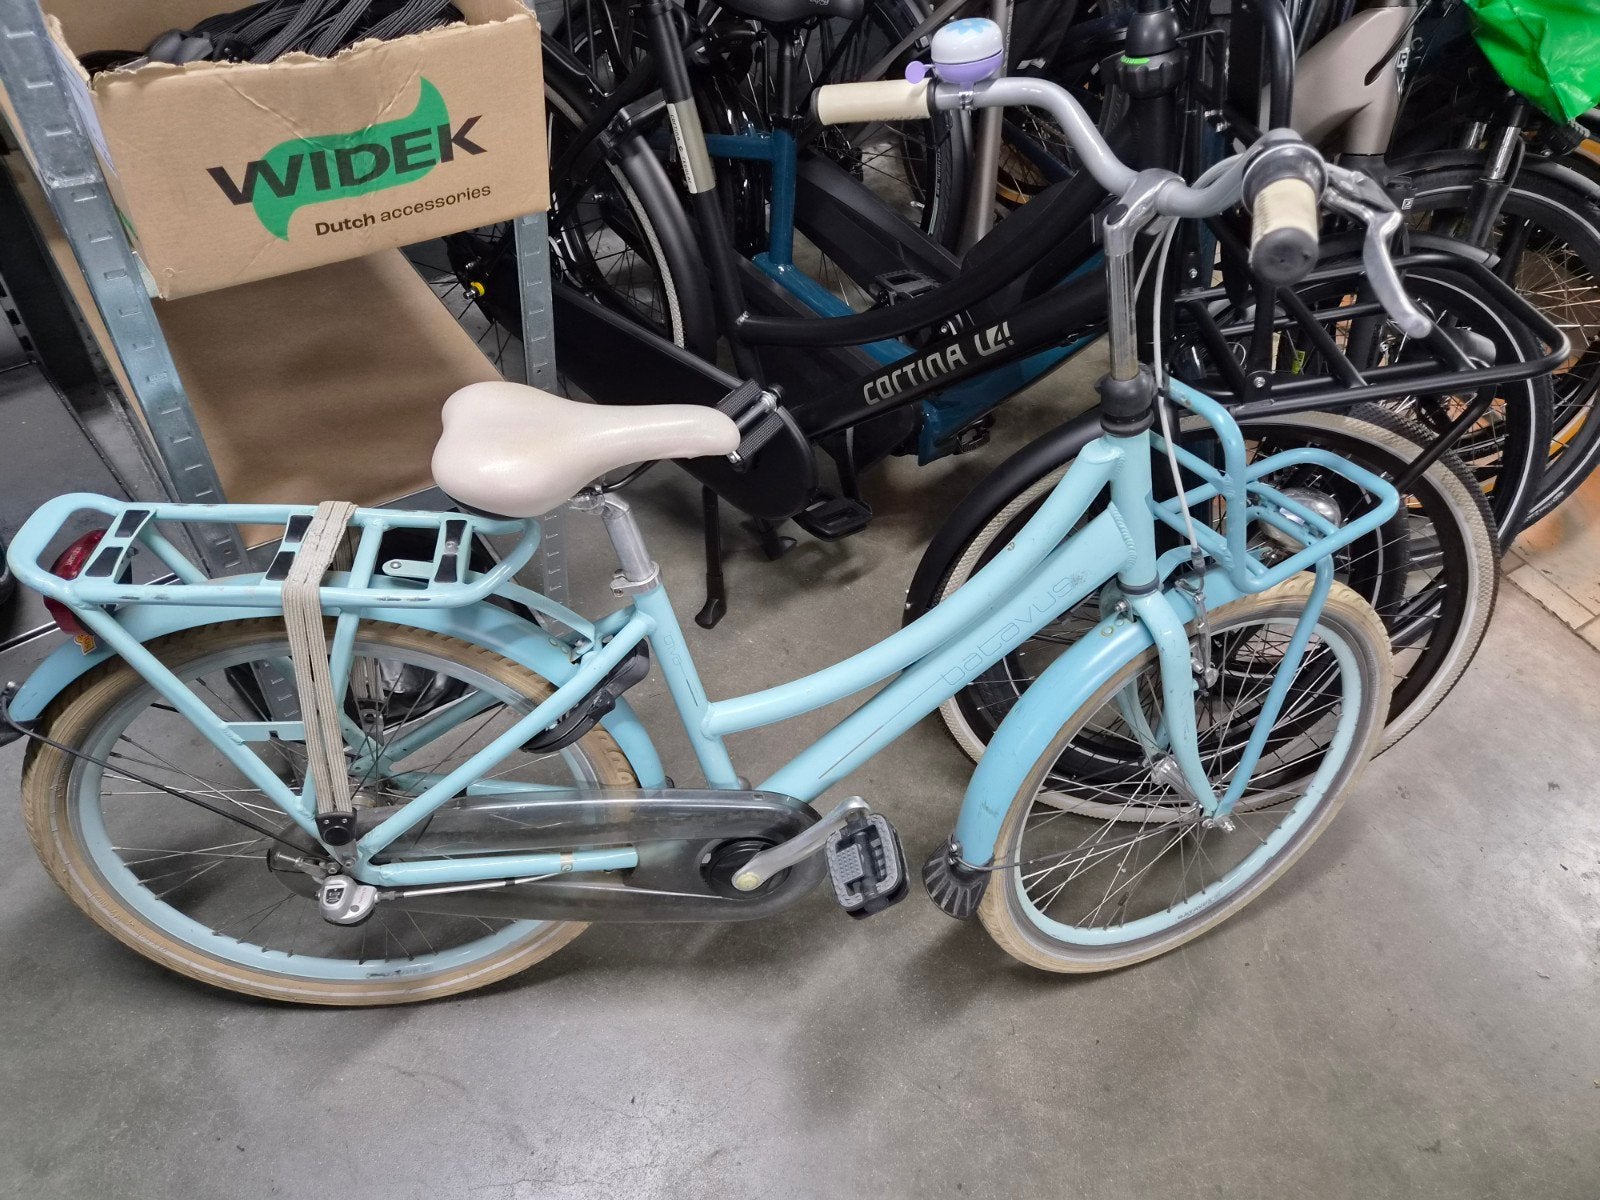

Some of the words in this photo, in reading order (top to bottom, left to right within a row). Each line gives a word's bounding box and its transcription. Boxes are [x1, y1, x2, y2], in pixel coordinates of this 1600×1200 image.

[206, 115, 488, 206] WIDEK
[315, 213, 376, 236] Dutch
[380, 185, 492, 222] accessories
[863, 343, 968, 406] CORTINA
